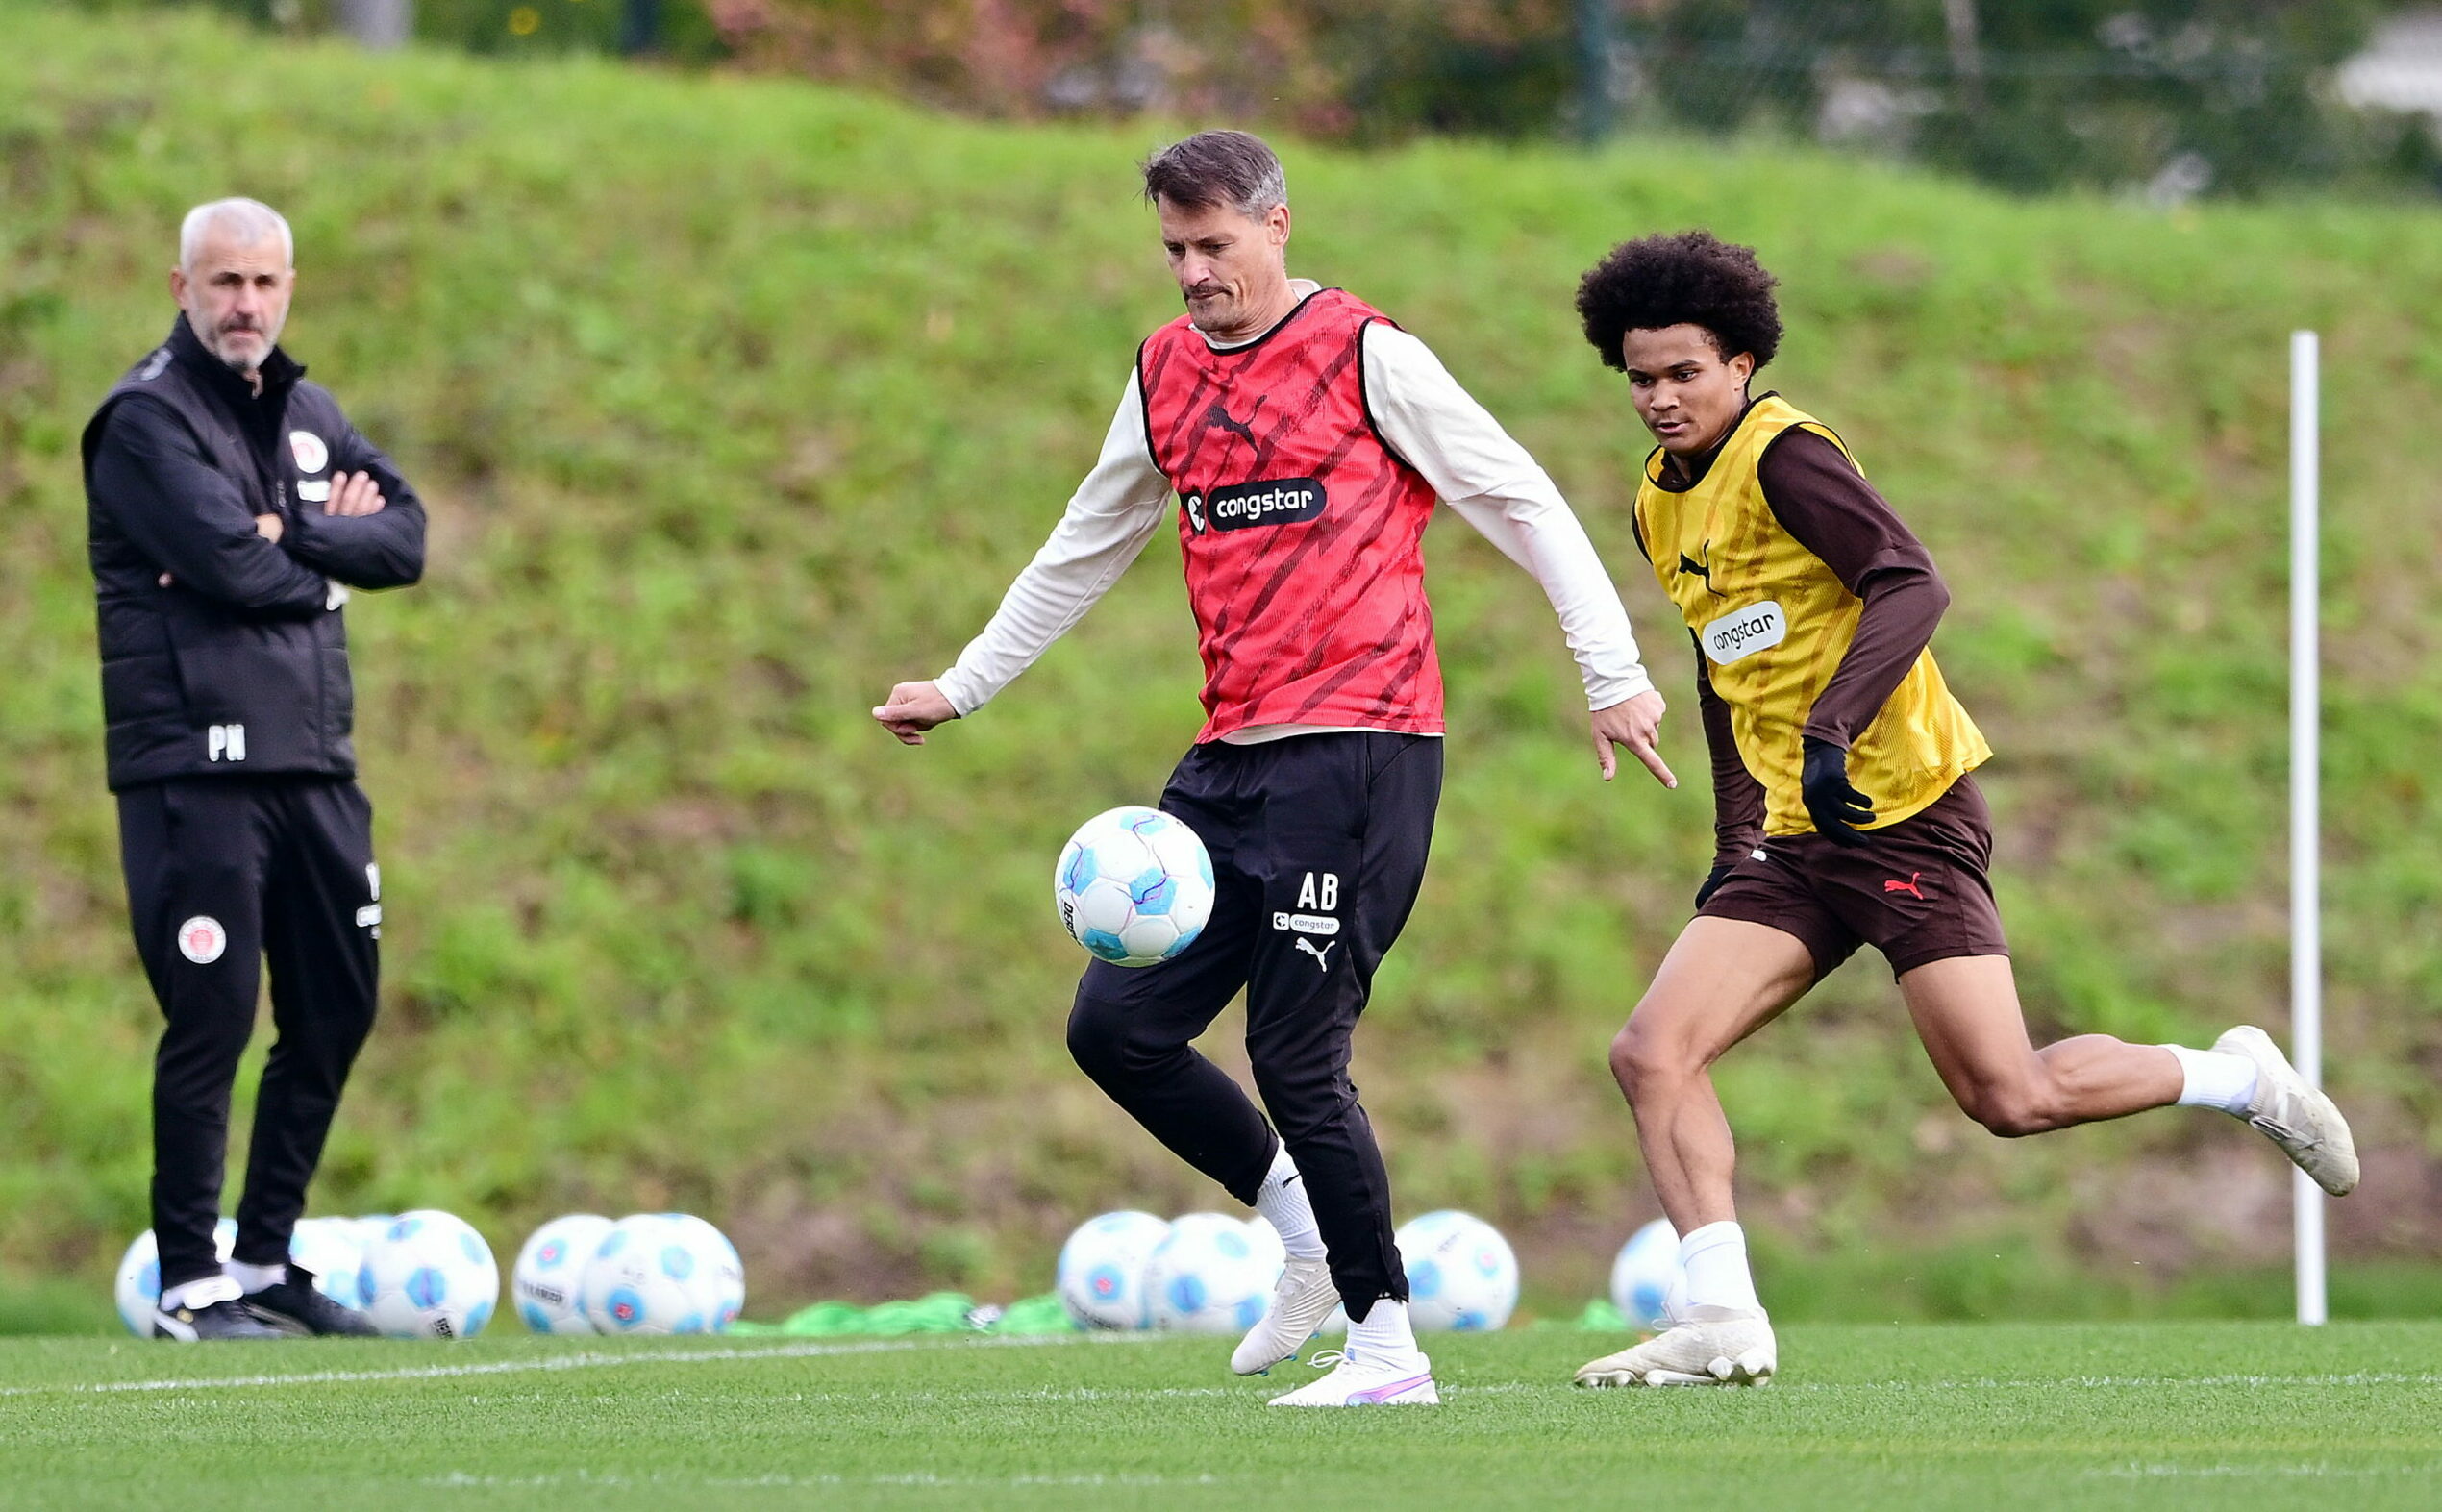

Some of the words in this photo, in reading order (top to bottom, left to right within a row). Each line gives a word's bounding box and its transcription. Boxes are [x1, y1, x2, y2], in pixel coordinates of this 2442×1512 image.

[1216, 488, 1313, 520] congstar
[1714, 614, 1774, 650] congstar
[1297, 871, 1338, 911] AB
[1294, 919, 1334, 930] congstar
